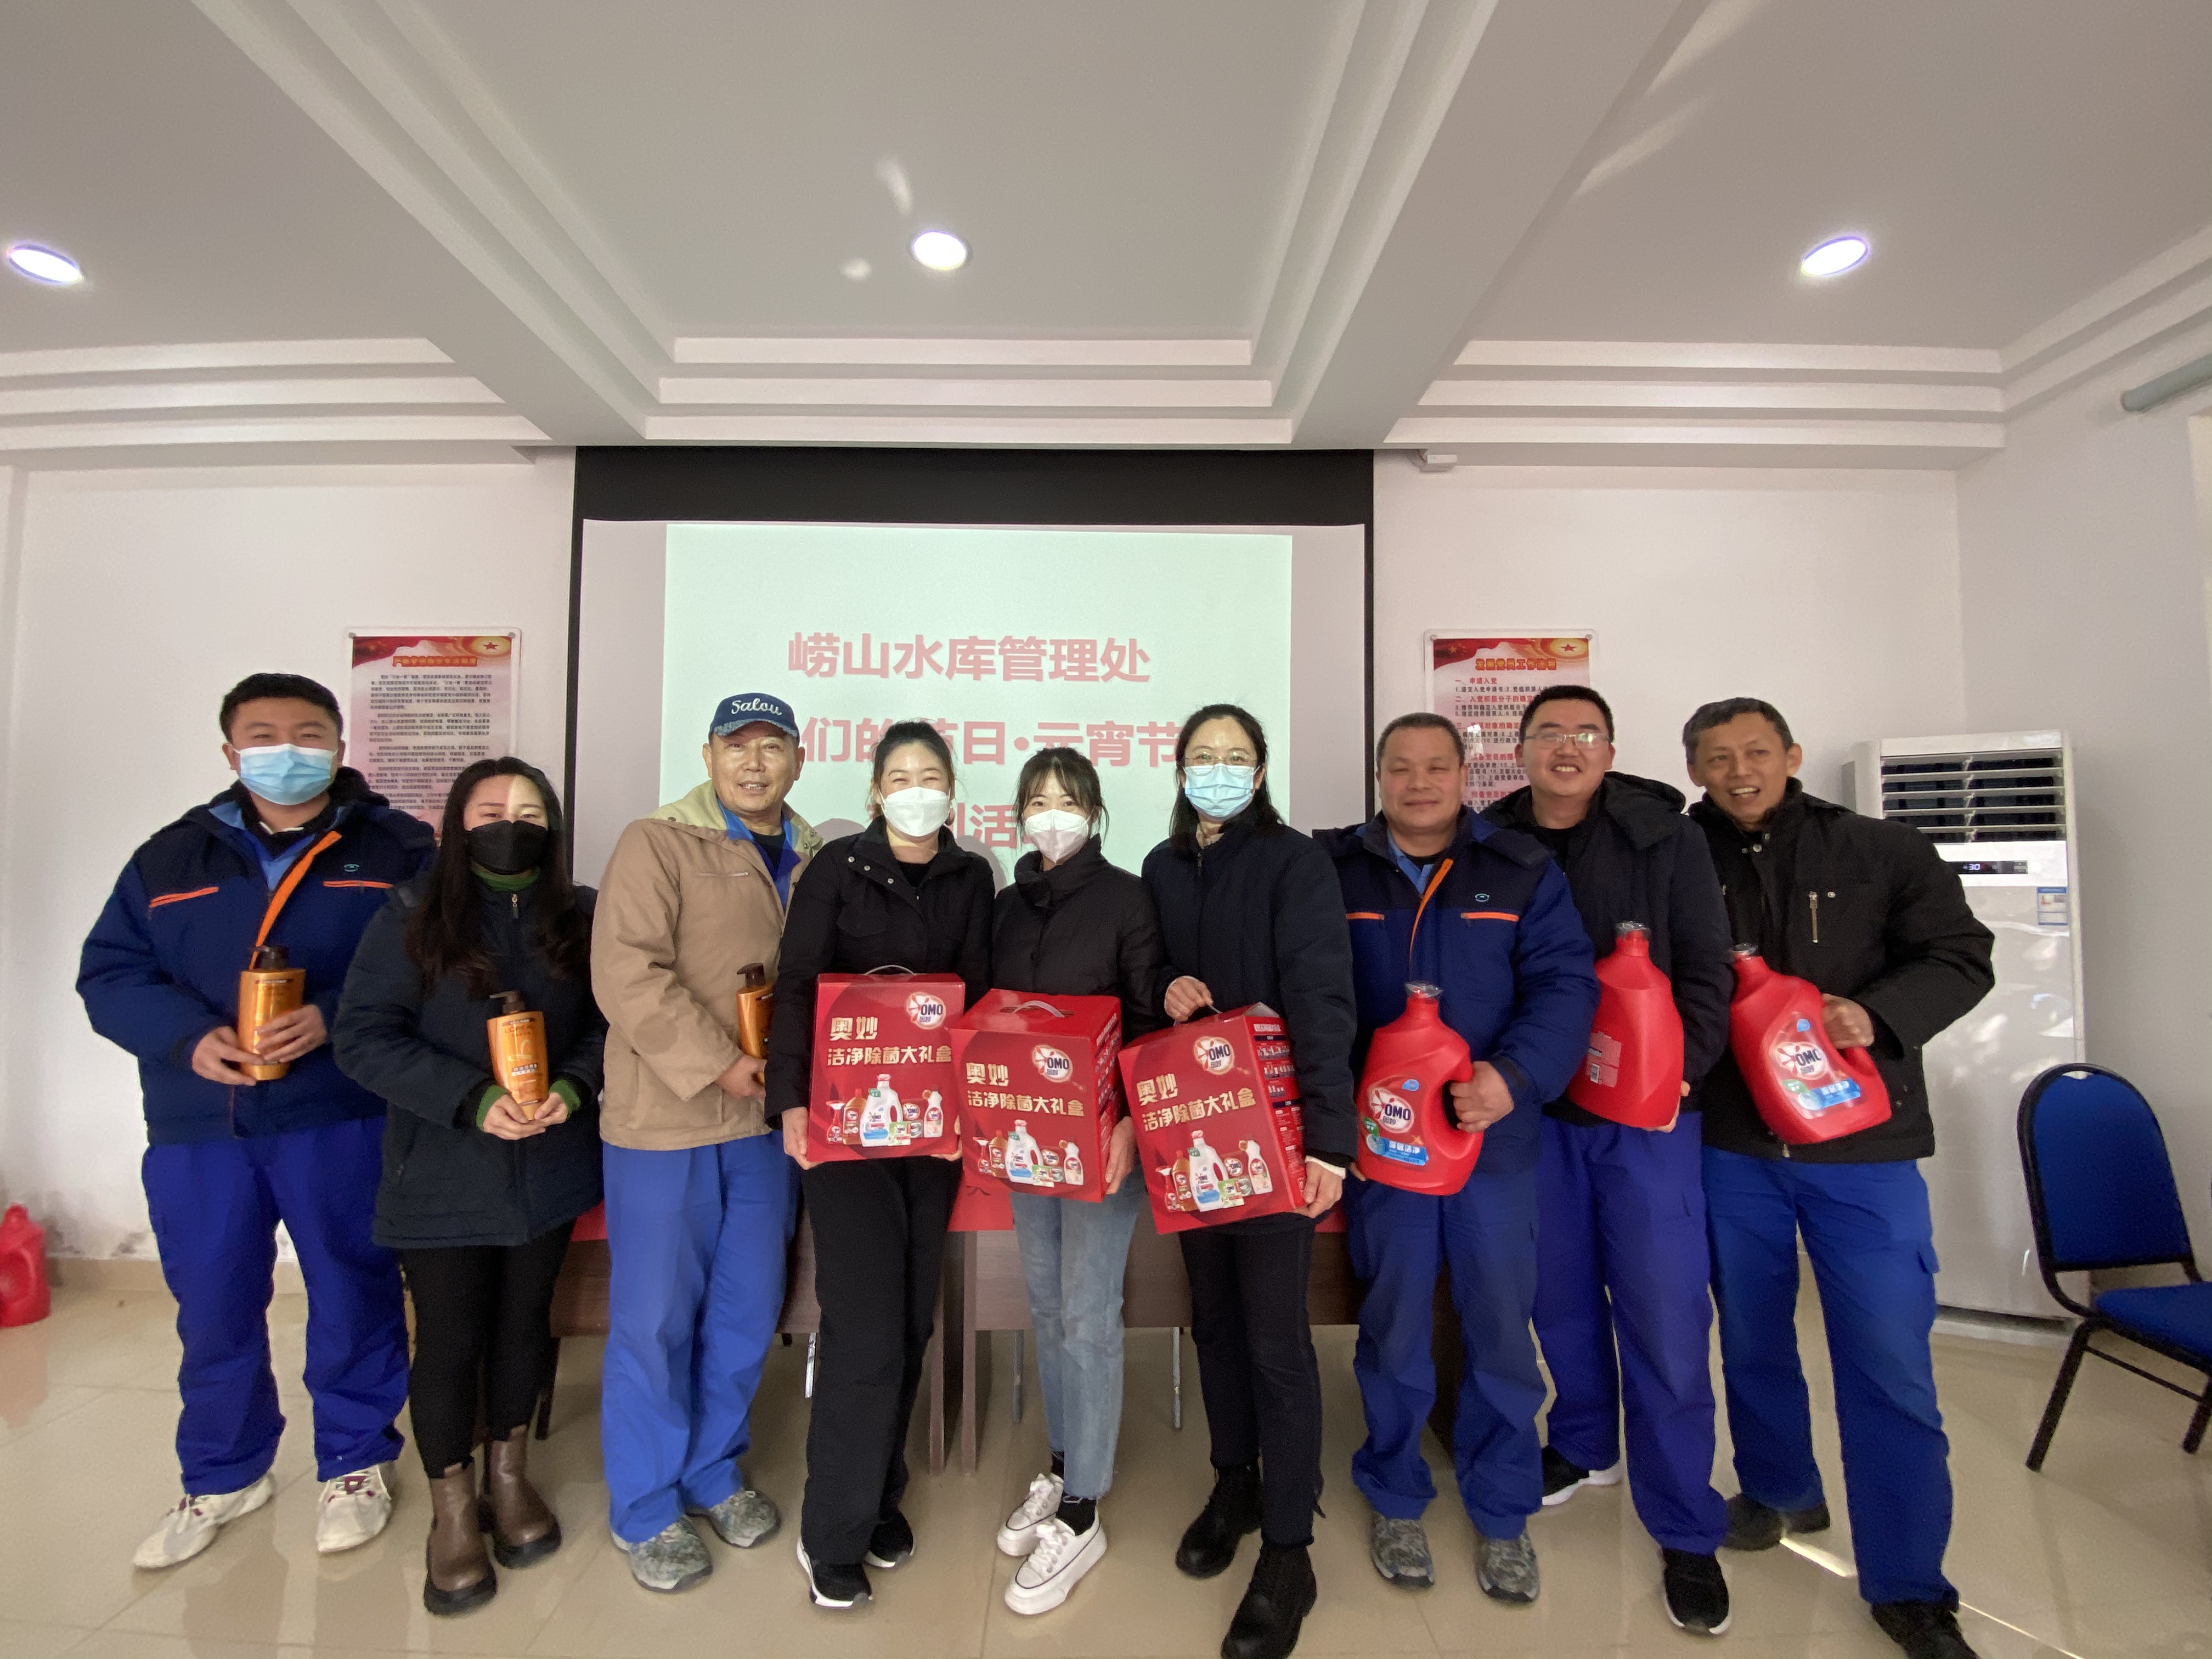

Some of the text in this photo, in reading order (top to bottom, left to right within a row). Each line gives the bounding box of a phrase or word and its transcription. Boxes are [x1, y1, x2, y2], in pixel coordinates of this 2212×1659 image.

[788, 631, 1150, 682] 崂山水库管理处
[731, 697, 782, 715] Salou
[921, 1003, 944, 1015] OMO
[830, 1016, 878, 1041] 奥妙
[827, 1045, 952, 1066] 洁净除菌大礼盒
[1209, 1043, 1231, 1060] OMO
[966, 1062, 1009, 1087] 奥妙
[1047, 1057, 1070, 1070] OMO
[1136, 1073, 1179, 1107] 奥妙
[967, 1090, 1085, 1117] 洁净除菌大礼盒
[1141, 1086, 1257, 1132] 洁净除菌大礼盒
[1384, 1104, 1412, 1121] OMO
